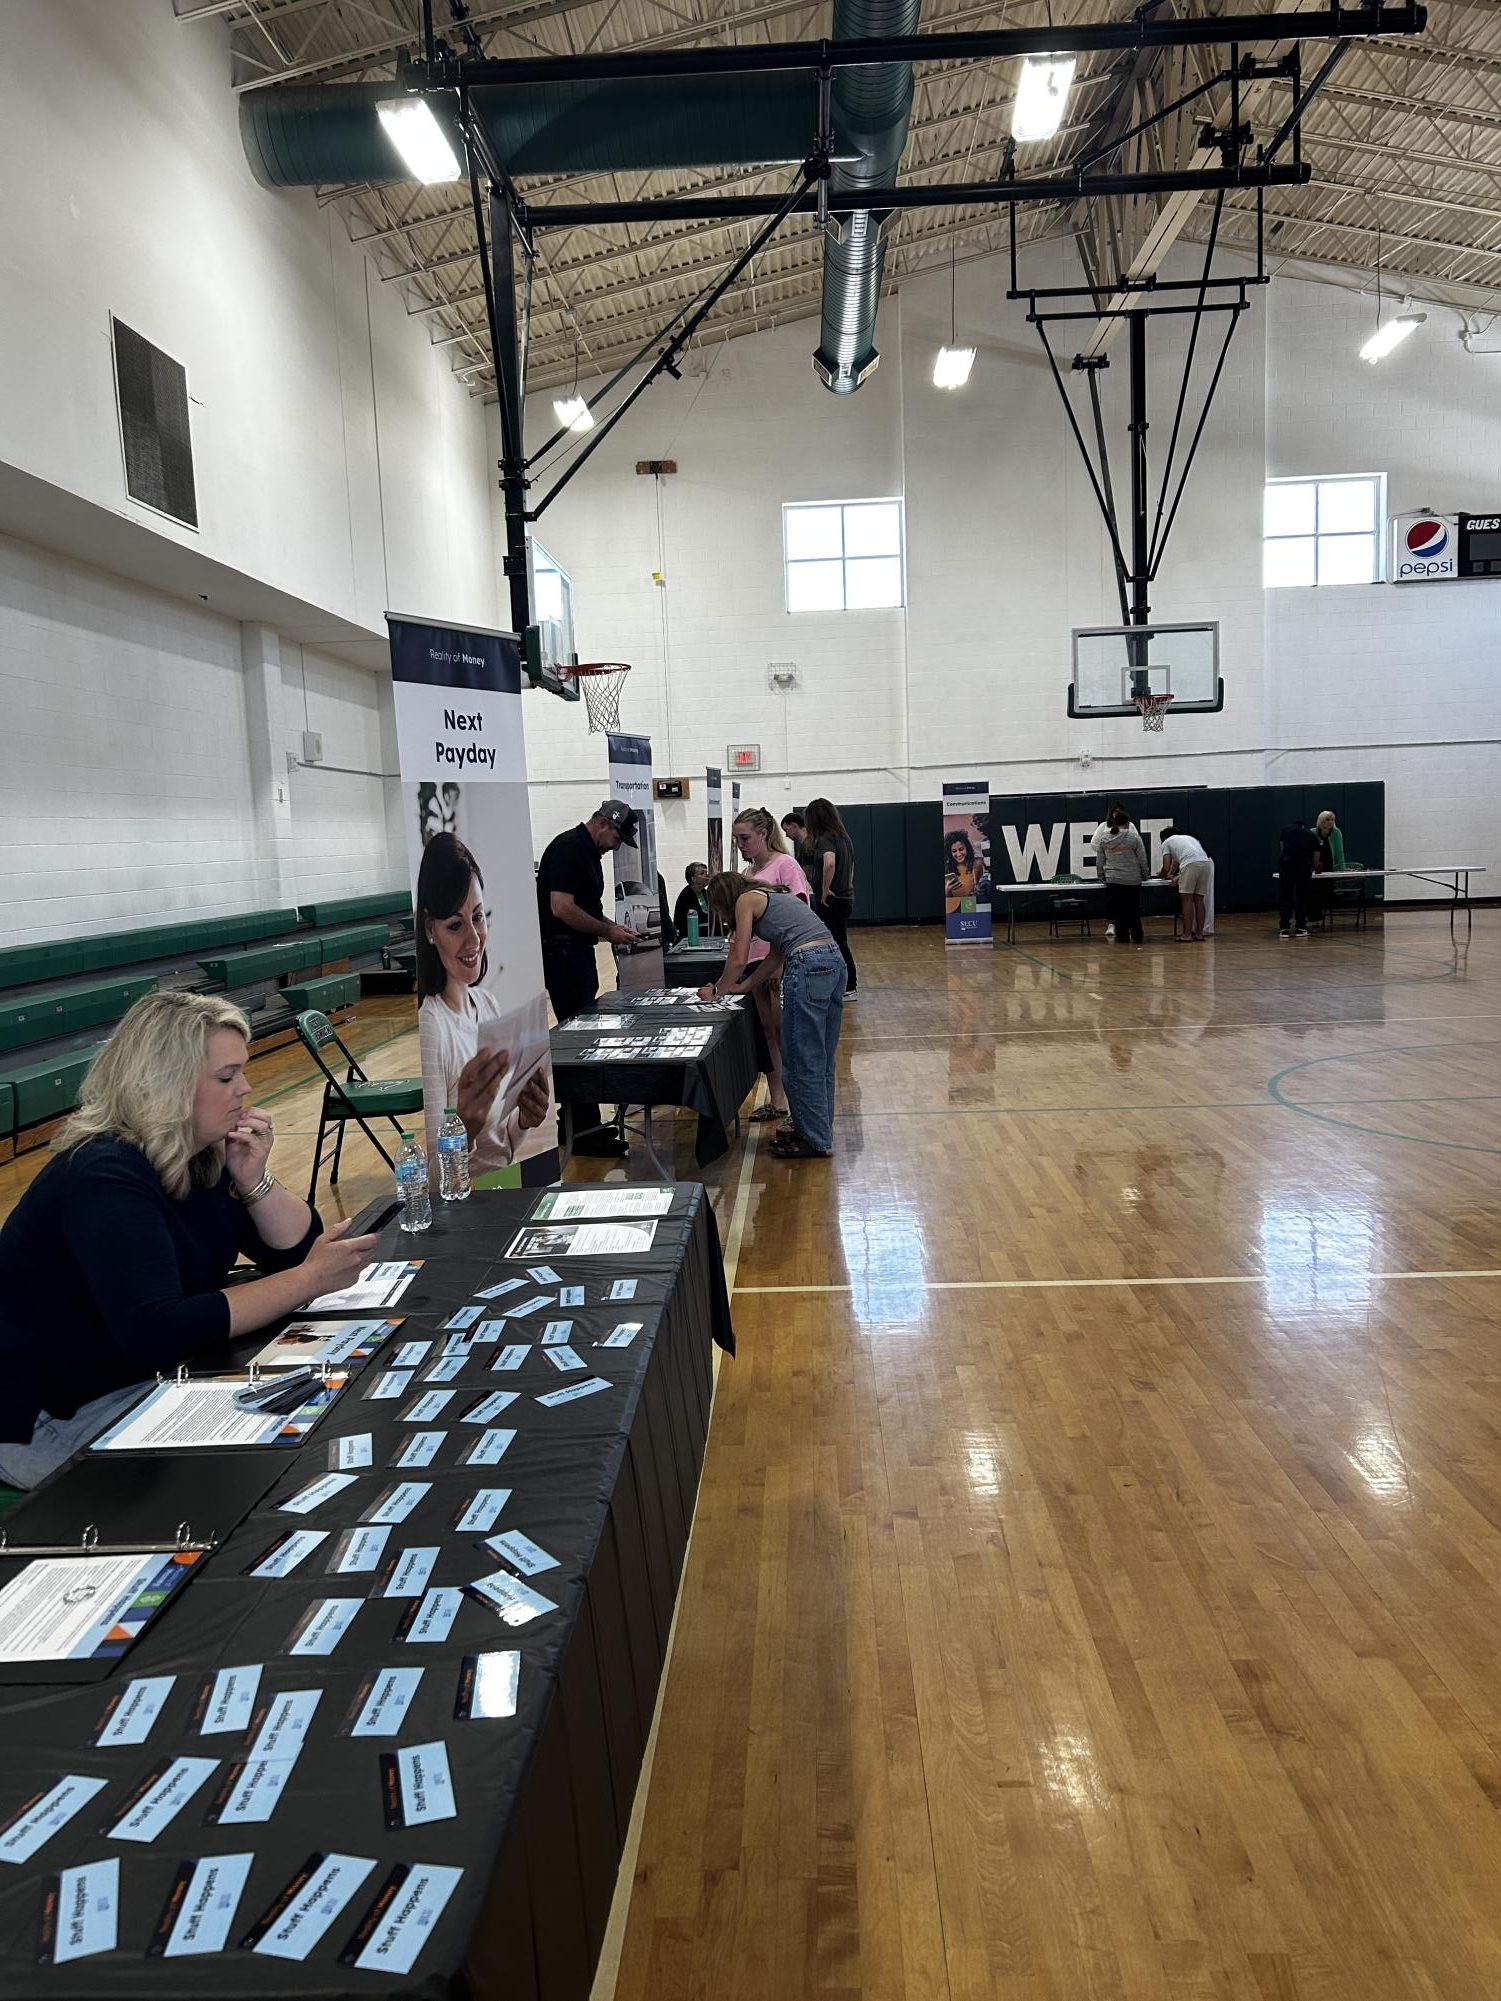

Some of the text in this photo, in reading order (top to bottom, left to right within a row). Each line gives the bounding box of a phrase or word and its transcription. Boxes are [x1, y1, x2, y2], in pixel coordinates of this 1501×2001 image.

[1466, 518, 1500, 530] GUES
[1400, 558, 1452, 578] pepsi
[430, 648, 484, 668] Reality of Money
[444, 710, 482, 732] Next
[436, 742, 496, 769] Payday
[1002, 818, 1174, 882] WET
[129, 1768, 189, 1828] Stuff Happens
[70, 1876, 89, 1946] Stuff Happens
[183, 1868, 219, 1940] Stuff Happens
[277, 1867, 341, 1940] Stuff Happens
[377, 1878, 429, 1954] Stuff Happens
